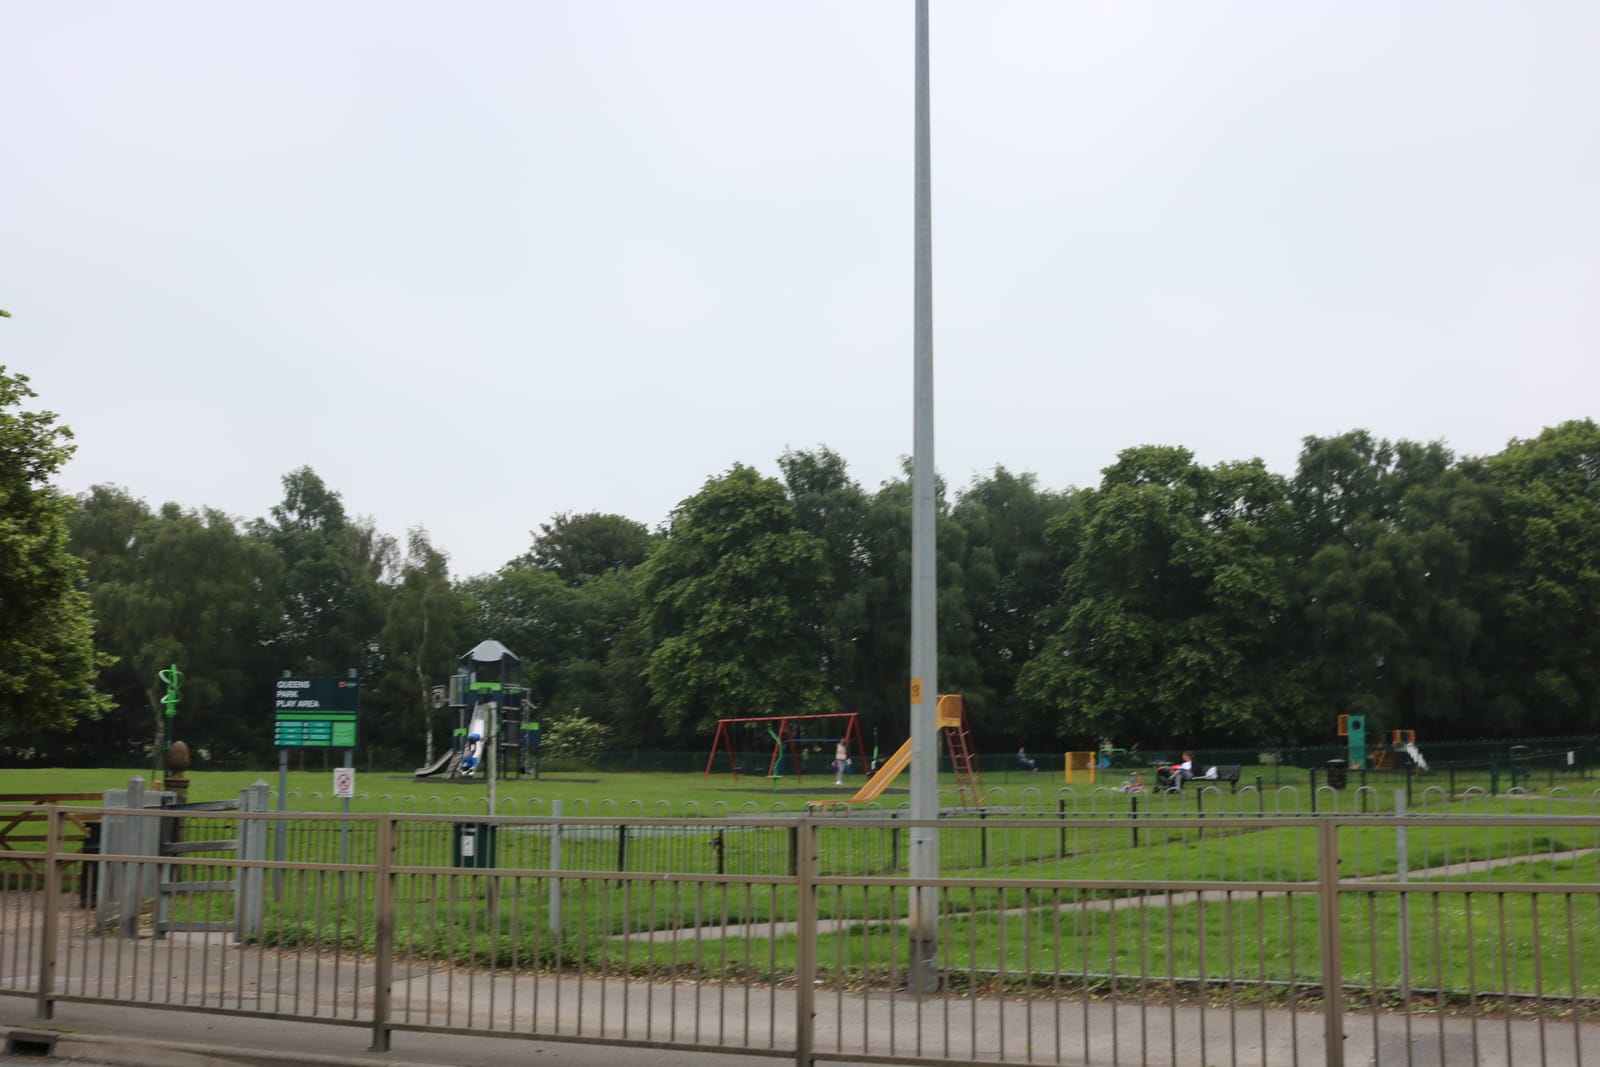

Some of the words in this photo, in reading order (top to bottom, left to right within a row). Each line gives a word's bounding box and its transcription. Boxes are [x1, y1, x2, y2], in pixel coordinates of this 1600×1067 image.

[276, 680, 310, 688] QUEENS
[276, 690, 298, 698] PARK
[276, 700, 296, 708] PLAY
[296, 700, 320, 708] AREA
